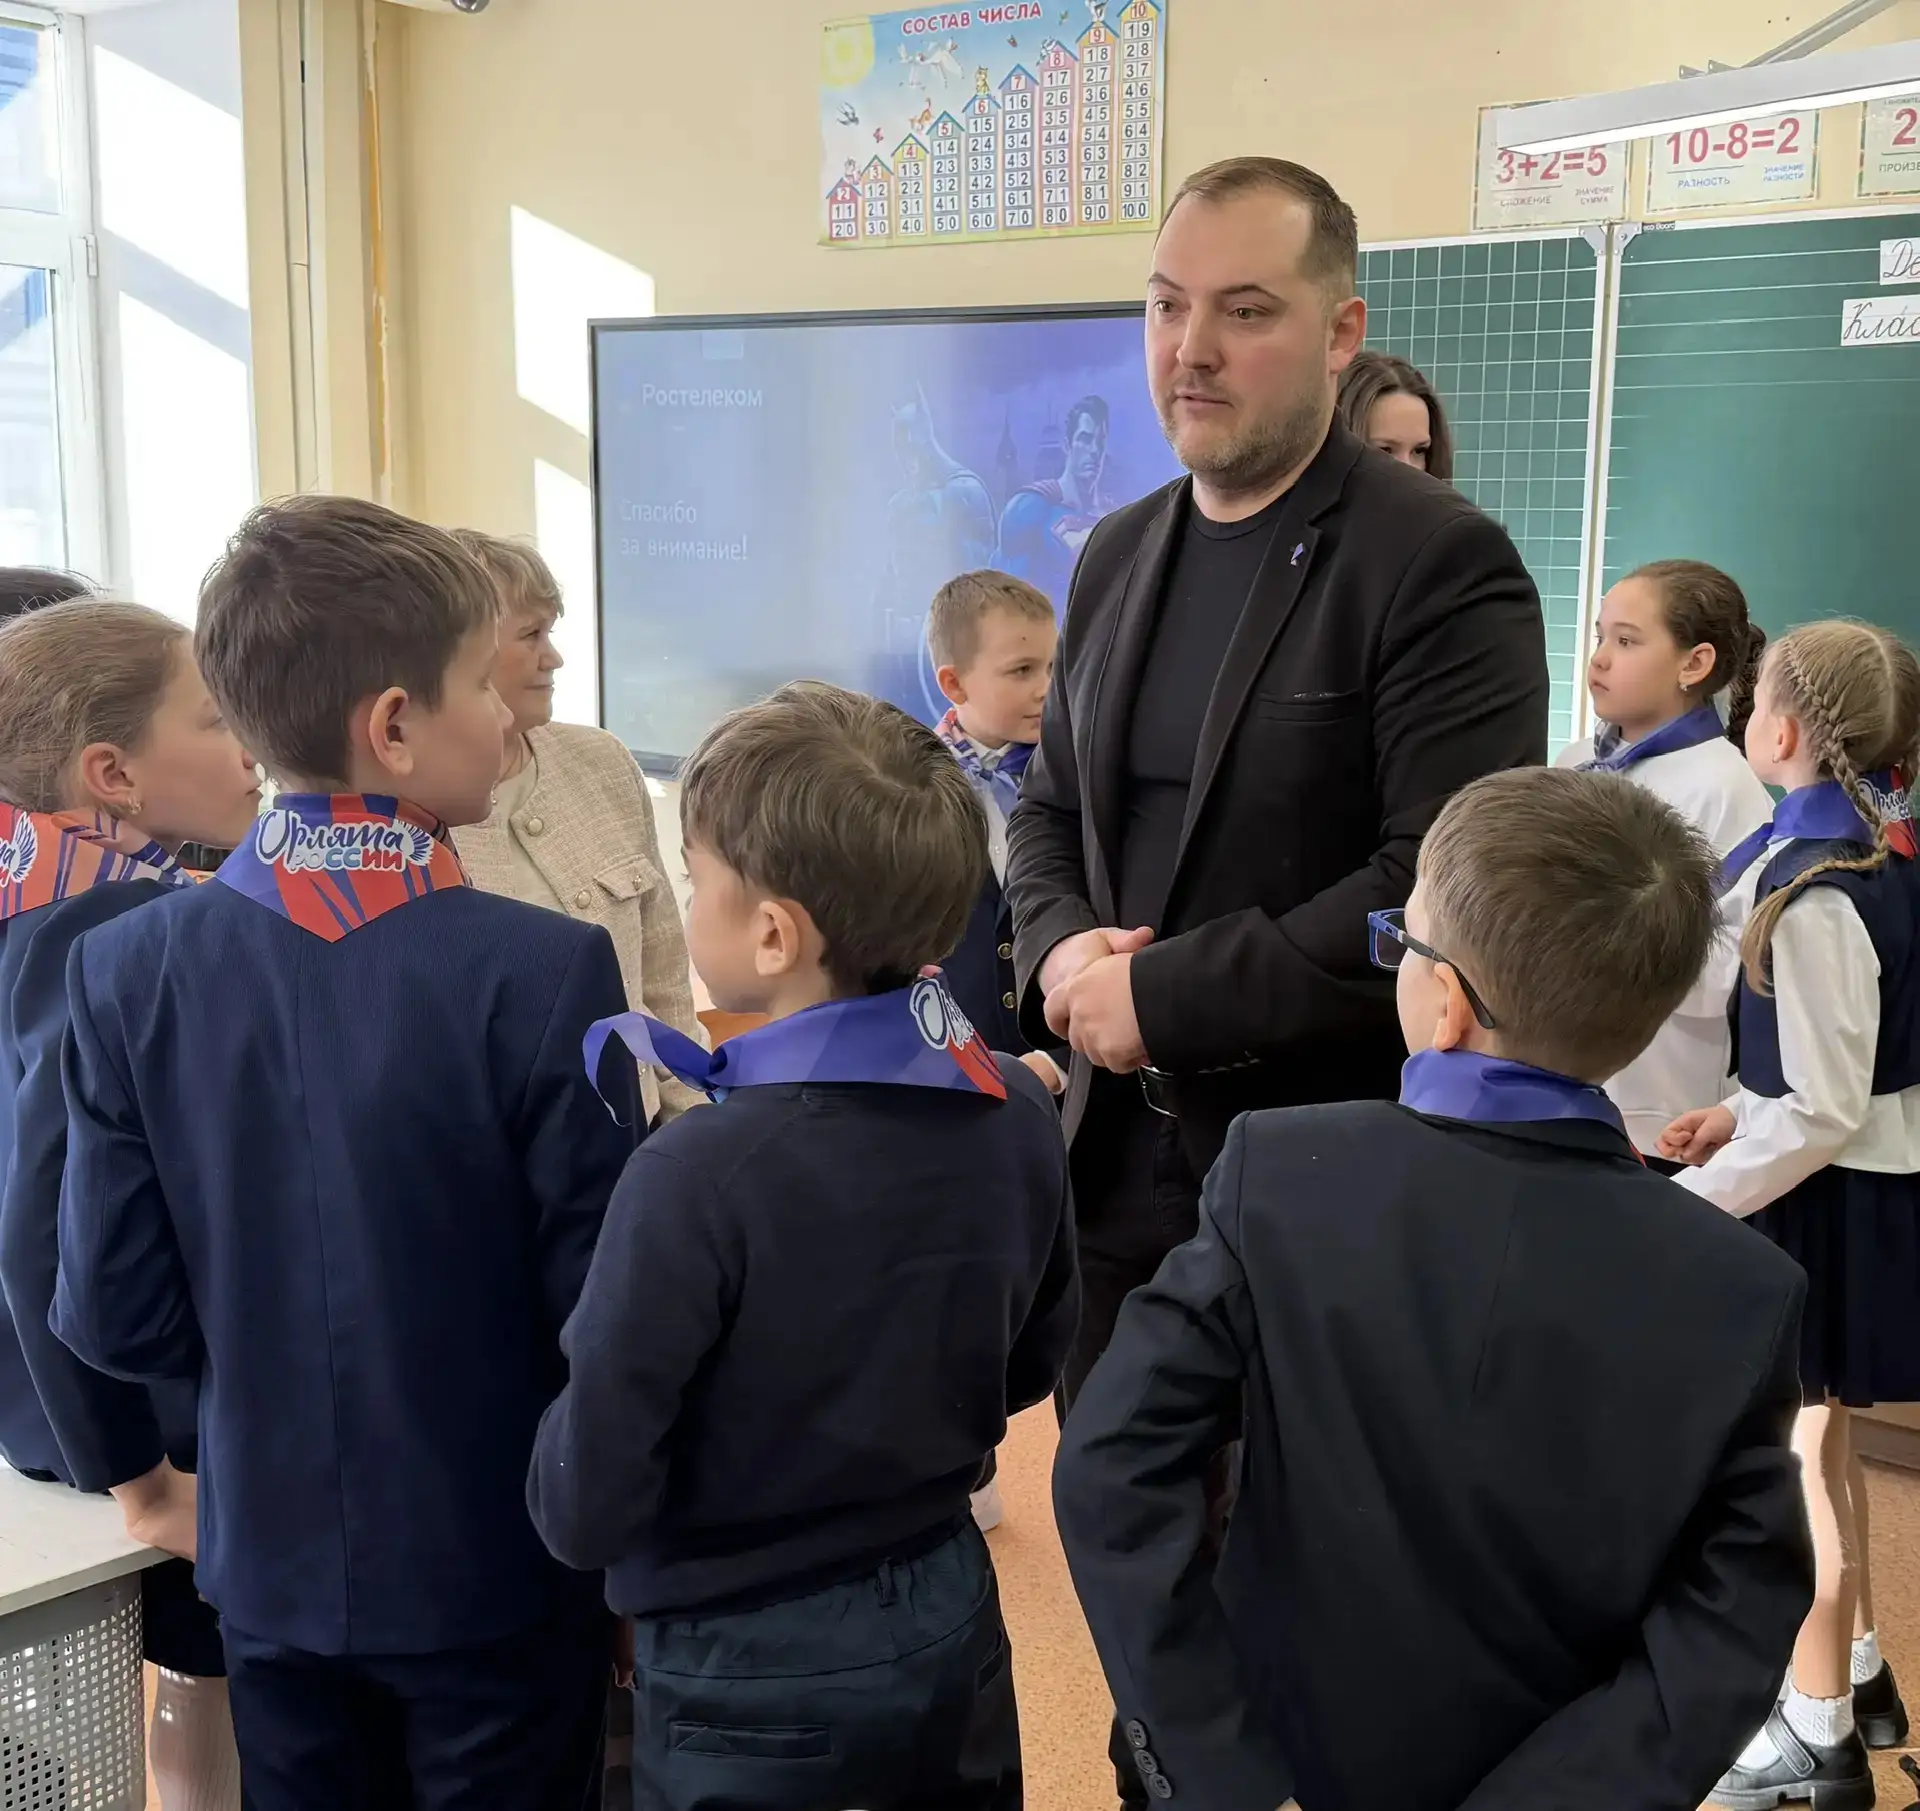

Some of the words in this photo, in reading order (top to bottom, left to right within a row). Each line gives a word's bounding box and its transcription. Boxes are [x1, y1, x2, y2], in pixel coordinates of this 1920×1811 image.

[1131, 3, 1146, 18] 10
[902, 12, 971, 35] СОСТАВ
[978, 2, 1042, 24] ЧИСЛА
[1093, 29, 1101, 43] 9
[1053, 52, 1062, 66] 8
[1014, 76, 1022, 89] 7
[977, 99, 986, 114] 6
[941, 122, 949, 136] 5
[1666, 117, 1800, 165] 10-8=2
[905, 143, 914, 157] 4
[1496, 144, 1607, 184] 3+2=5
[1764, 163, 1804, 174] ЗНАЧЕНИЕ
[871, 165, 880, 179] 3
[1763, 172, 1804, 182] РАЗНОСТИ
[1677, 176, 1730, 188] РАЗНОСТЬ
[839, 186, 848, 201] 2
[642, 383, 763, 407] Ростелеком
[621, 500, 697, 524] Спасибо
[621, 538, 640, 555] за
[648, 534, 748, 560] внимание!
[259, 810, 405, 865] Орлята
